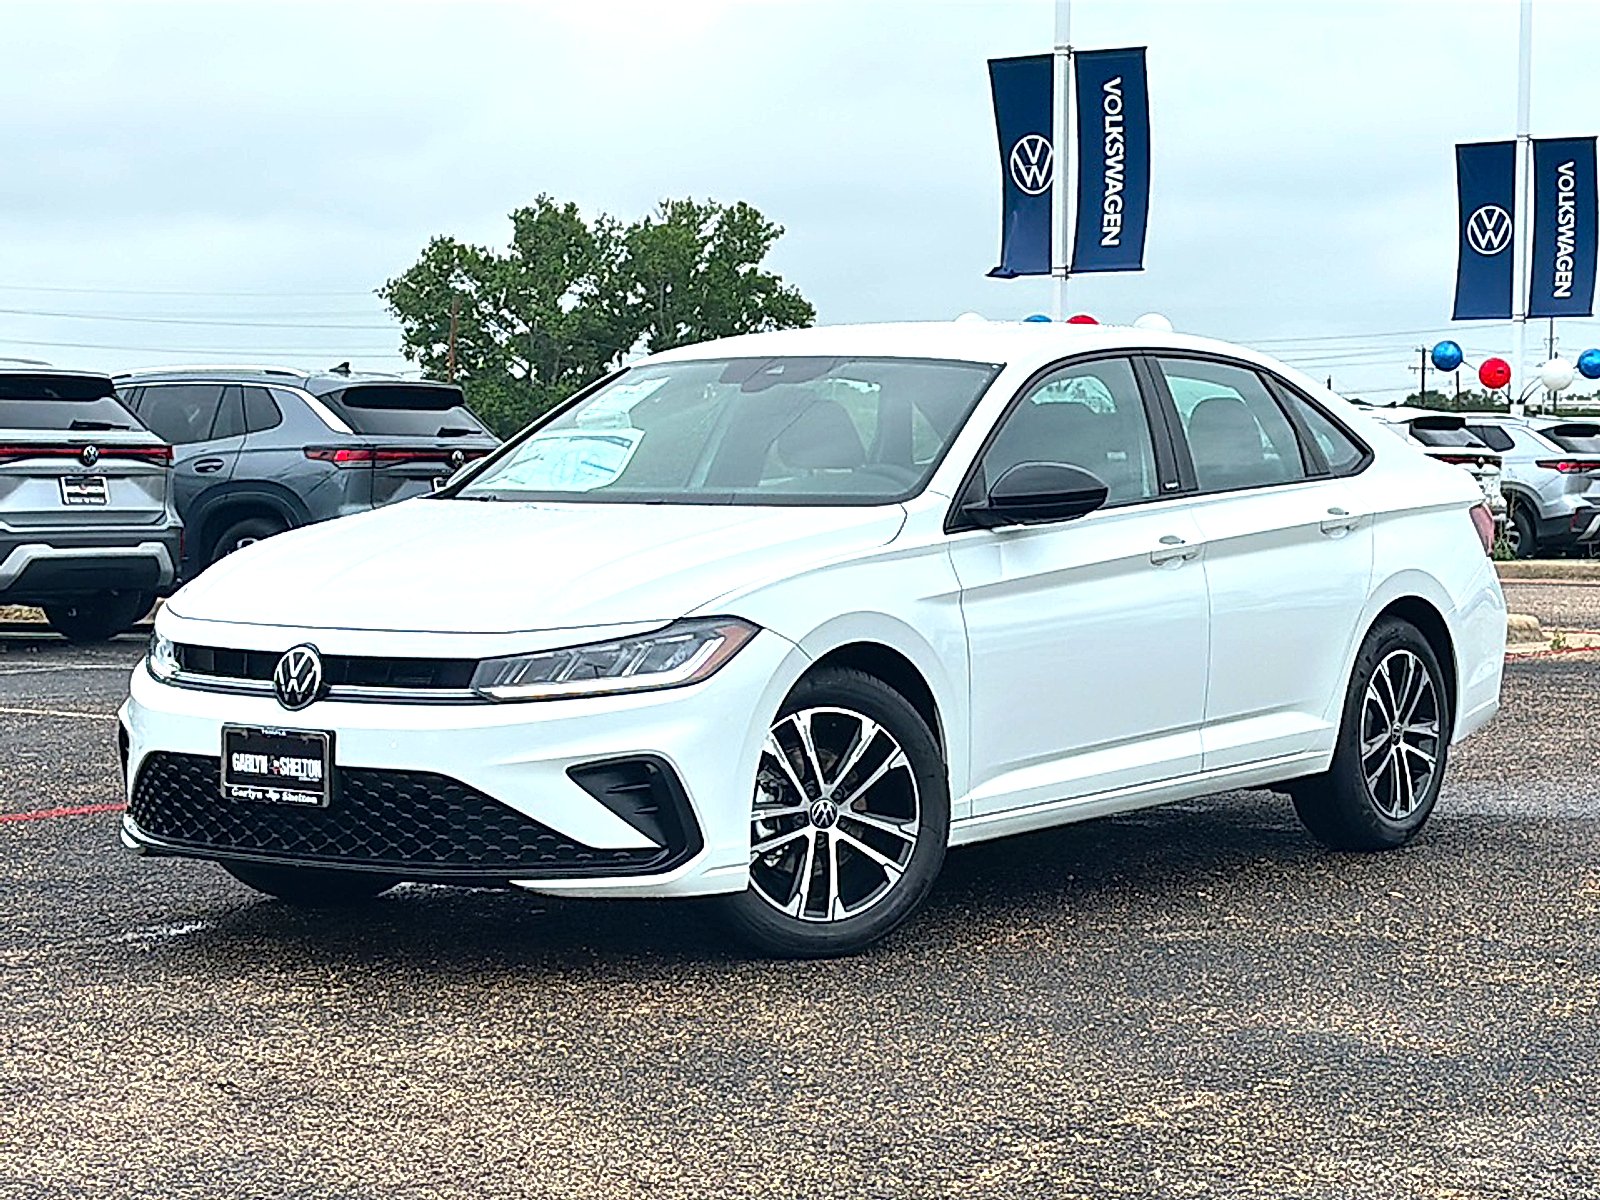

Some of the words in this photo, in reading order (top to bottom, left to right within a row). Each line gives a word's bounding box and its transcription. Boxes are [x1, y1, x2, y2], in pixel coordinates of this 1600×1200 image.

[1011, 135, 1054, 194] VW
[1101, 76, 1124, 247] VOLKSWAGEN
[1467, 205, 1513, 255] VW
[1553, 161, 1575, 298] VOLKSWAGEN
[274, 646, 322, 710] VW
[232, 752, 268, 774] GARLYN
[280, 756, 322, 778] SHELTON
